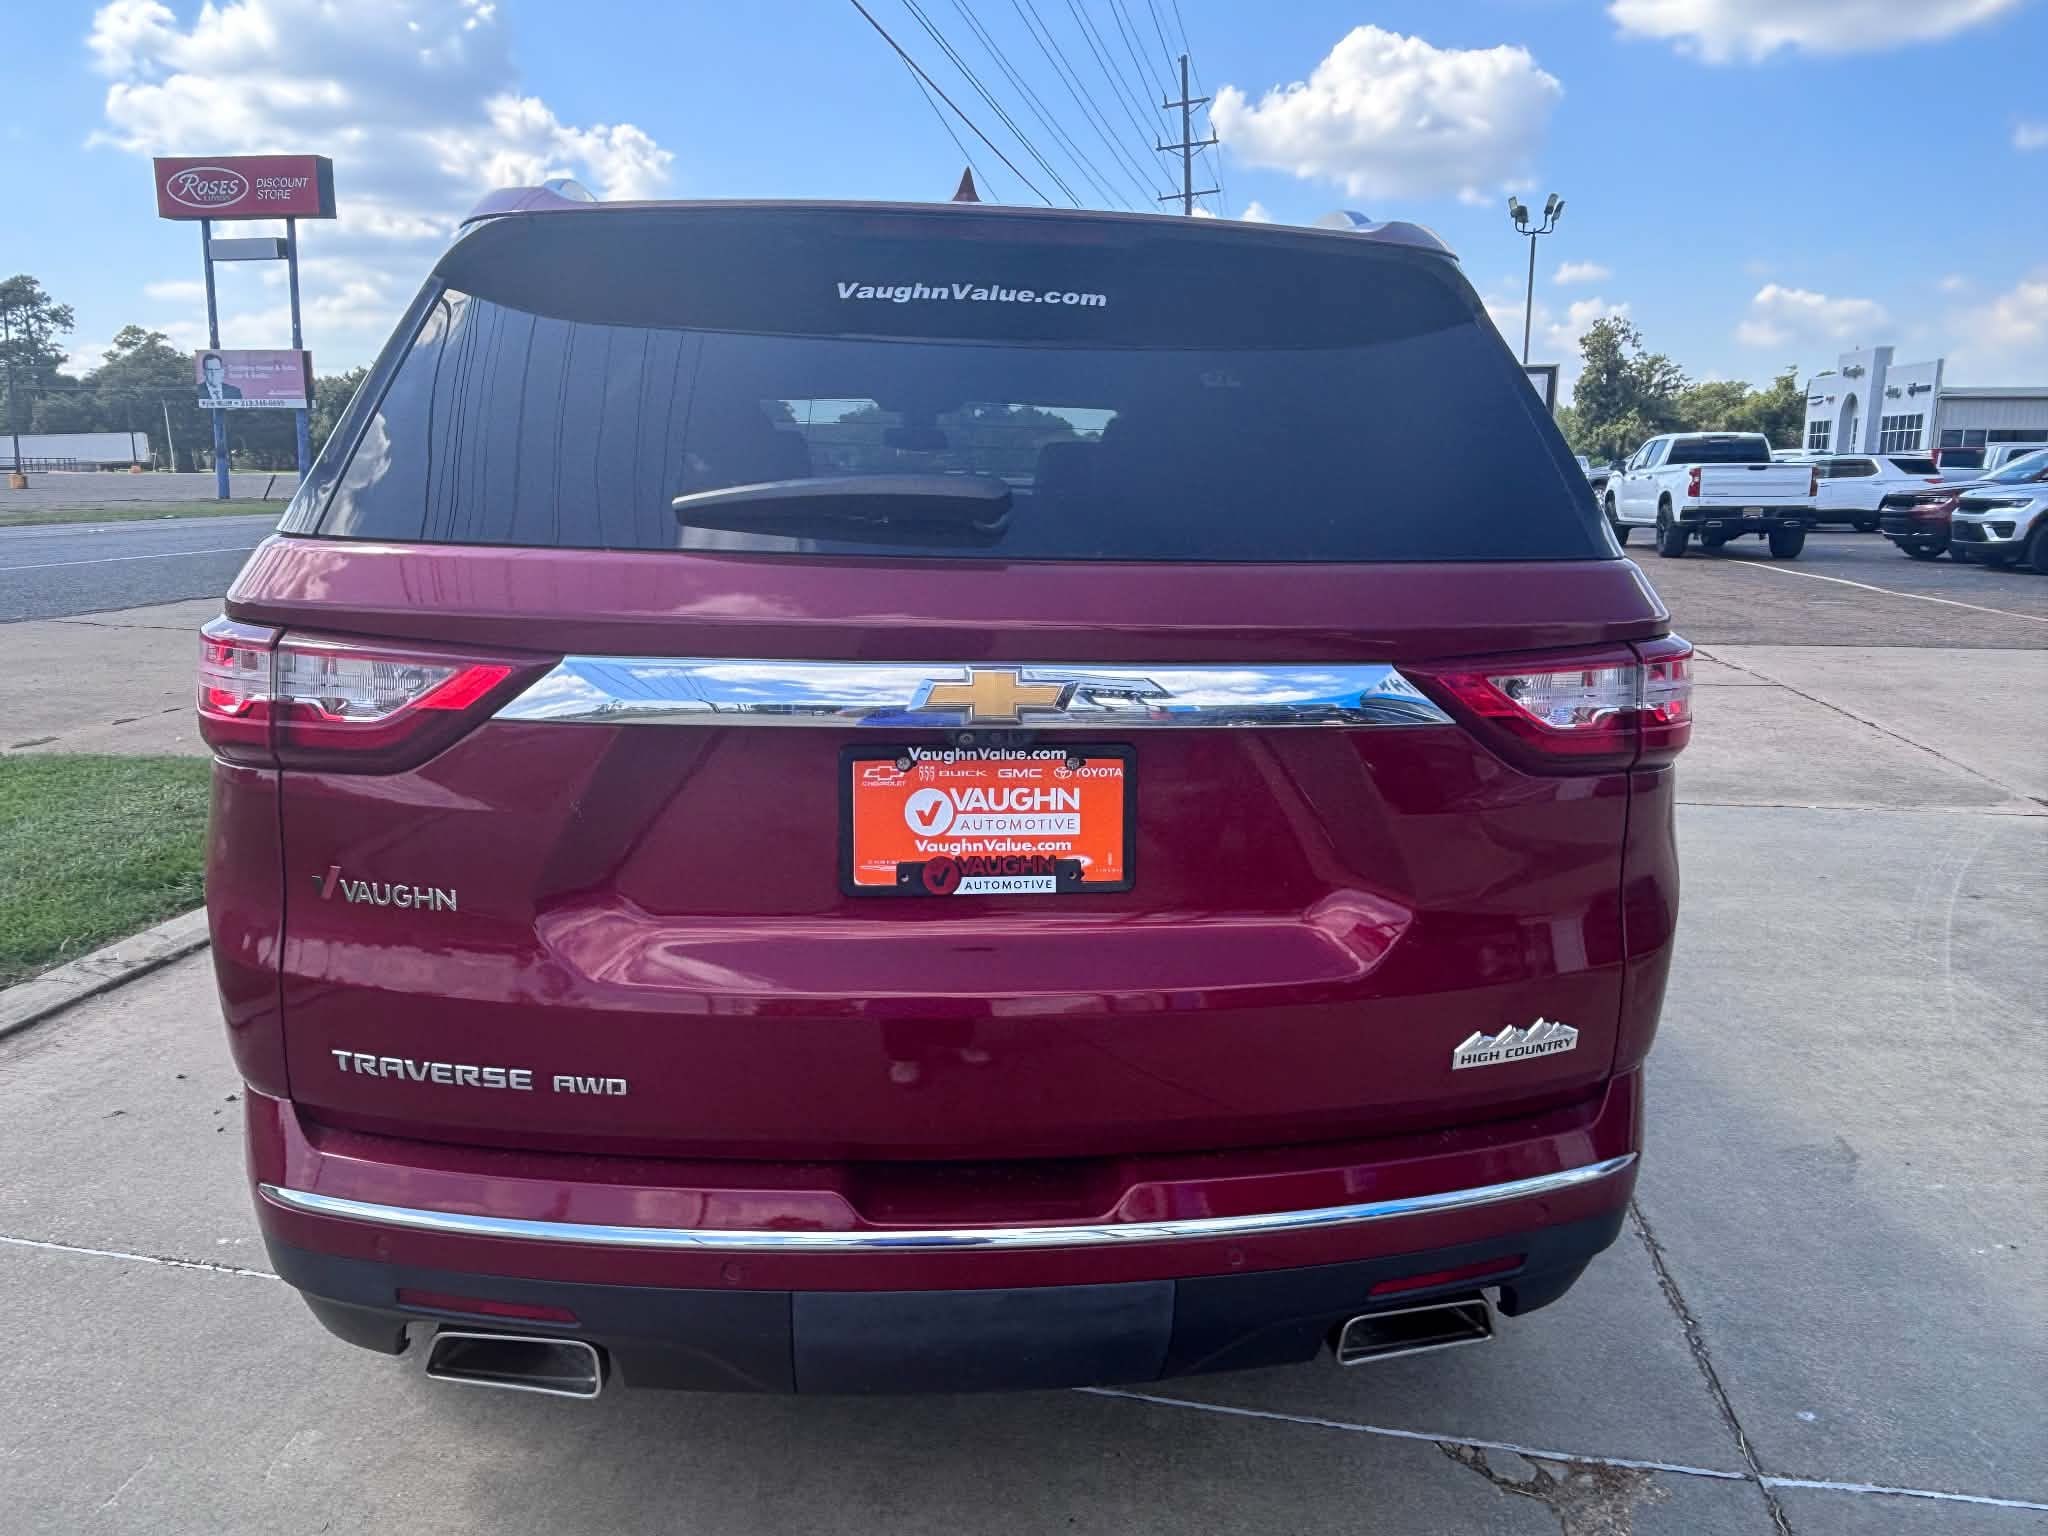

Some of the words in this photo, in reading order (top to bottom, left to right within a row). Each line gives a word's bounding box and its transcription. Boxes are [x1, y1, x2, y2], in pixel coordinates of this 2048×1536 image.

[256, 177, 308, 189] DISCOUNT
[257, 189, 291, 200] STORE
[836, 282, 1107, 306] VaughnValue.com
[908, 747, 1067, 765] VaughnValue.com
[938, 769, 988, 777] BUICK
[998, 768, 1042, 778] GMC
[1076, 767, 1123, 778] TOYOTA
[950, 787, 1081, 811] VAUGHN
[960, 818, 1076, 831] AUTOMOTIVE
[914, 838, 1072, 856] VaughnValue.com
[951, 855, 1056, 875] VAUGHN
[964, 878, 1054, 891] AUTOMOTIVE
[339, 879, 457, 911] VAUGHN
[1460, 1049, 1500, 1065] HIGH
[1505, 1037, 1574, 1059] COUNTRY
[331, 1049, 533, 1091] TRAVERSE
[552, 1074, 628, 1096] AWD
